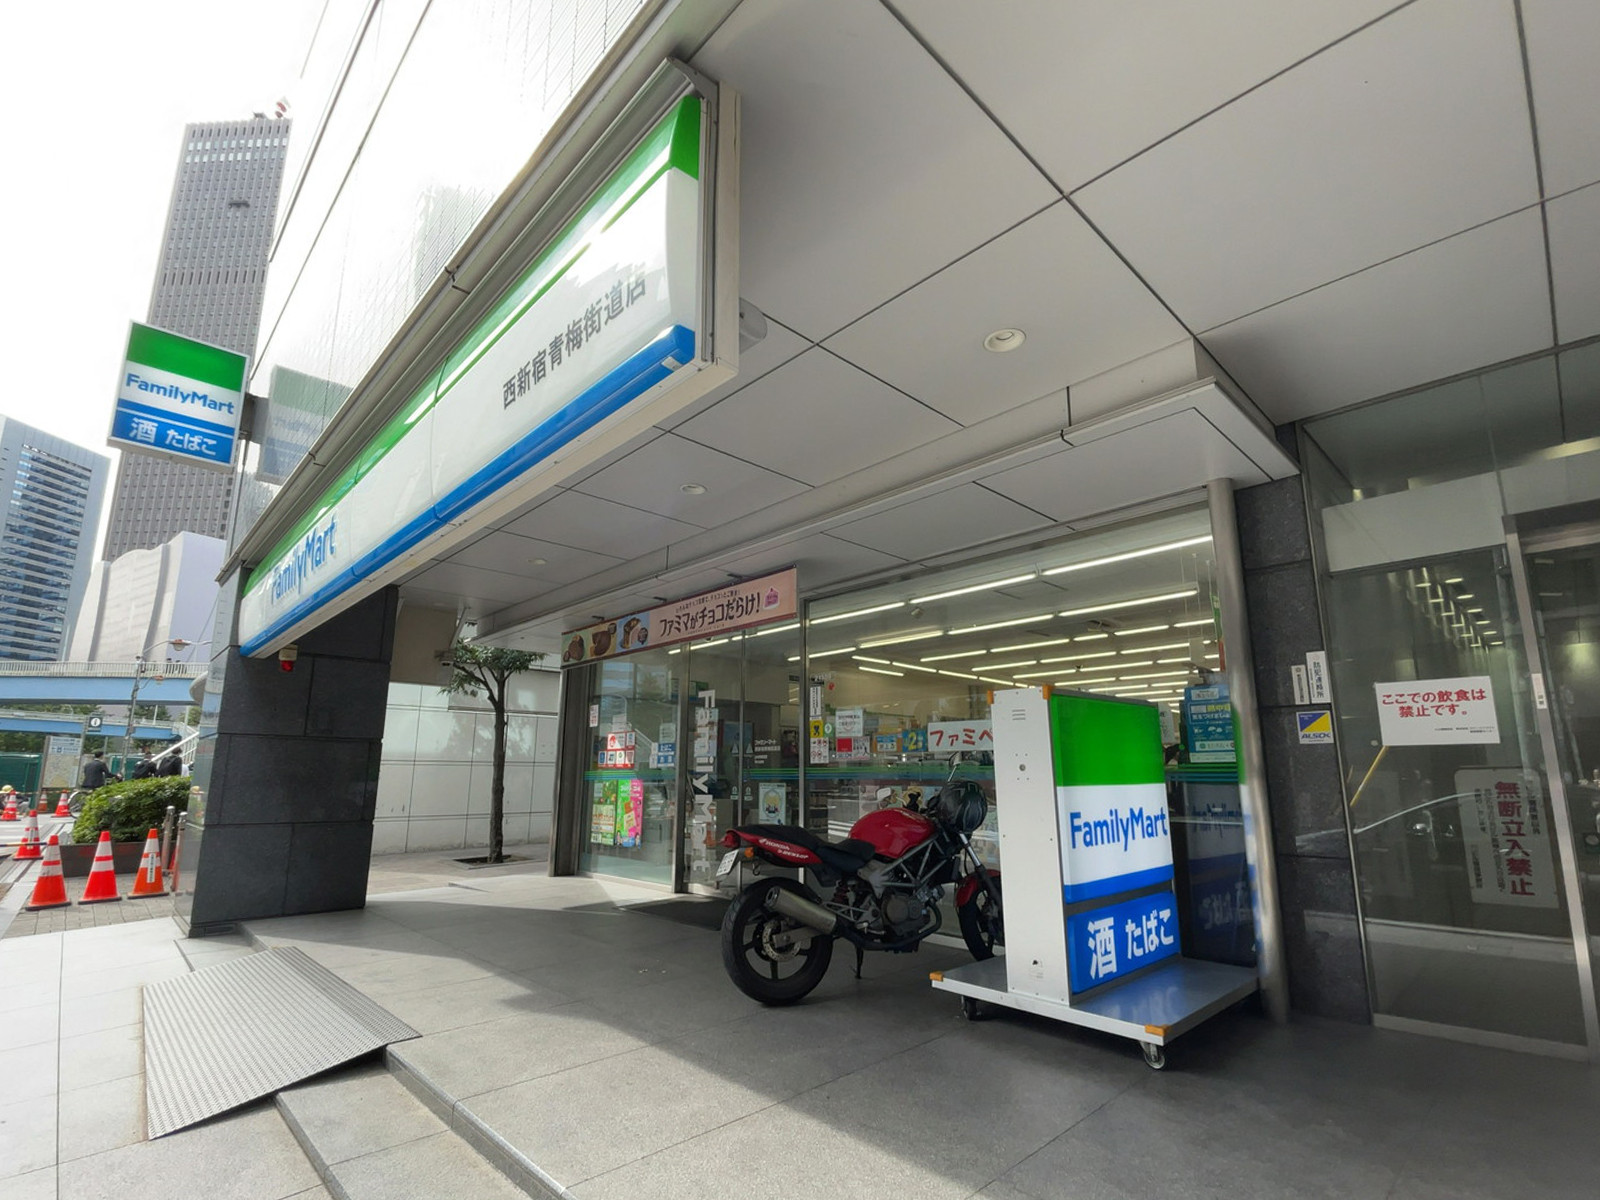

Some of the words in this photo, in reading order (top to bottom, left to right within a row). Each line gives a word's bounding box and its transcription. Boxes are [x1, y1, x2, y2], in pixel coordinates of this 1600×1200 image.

[126, 373, 235, 415] FamilyMart
[129, 417, 159, 443] 酒
[165, 429, 217, 456] たばこ
[271, 513, 337, 605] FamilyMart
[660, 592, 761, 637] ファミマがチョコだらけ!
[1382, 688, 1487, 705] ここでの飲食は
[1399, 704, 1467, 718] 禁止です。
[1301, 732, 1331, 740] ALSOK
[765, 840, 790, 851] HONDA
[1069, 807, 1168, 852] FamilyMart
[1494, 781, 1536, 896] 無断立入禁止
[1087, 916, 1117, 980] 酒
[1125, 908, 1174, 960] たばこ
